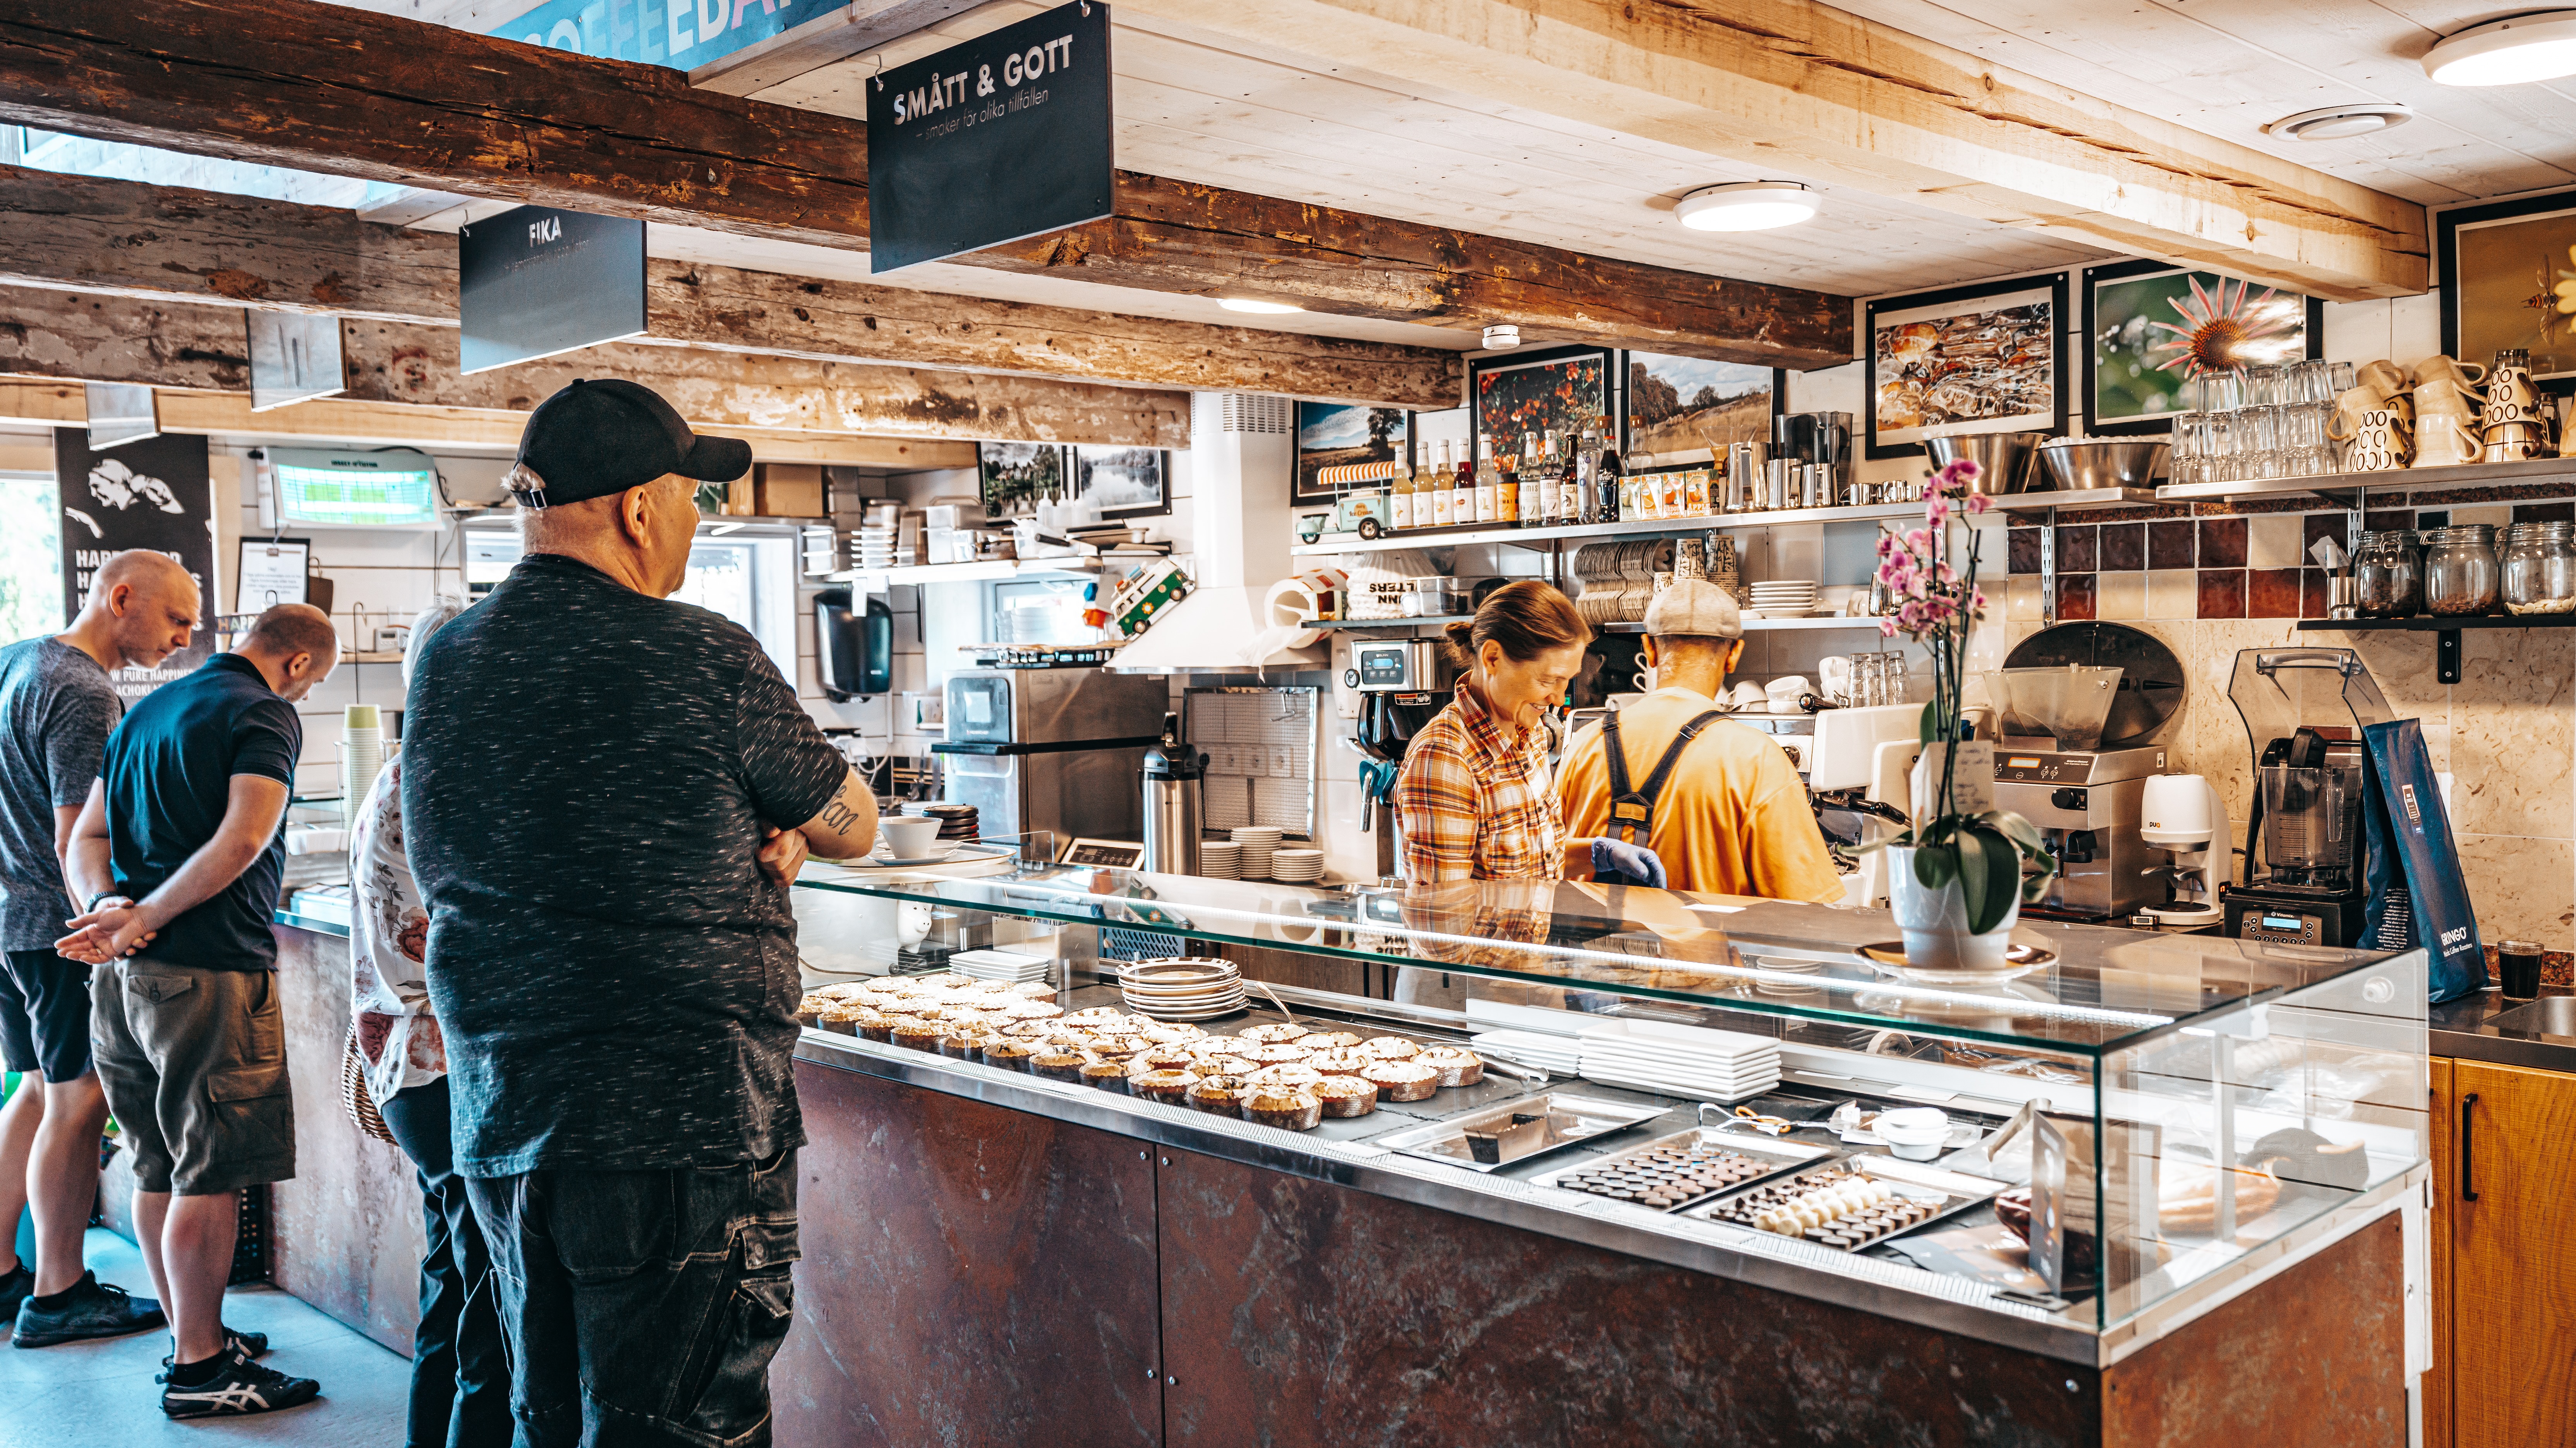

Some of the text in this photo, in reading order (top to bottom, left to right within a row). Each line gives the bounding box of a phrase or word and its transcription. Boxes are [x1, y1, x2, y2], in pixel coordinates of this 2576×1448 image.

[894, 34, 1073, 125] SMÅTT & GOTT
[926, 117, 960, 140] smaker
[963, 108, 977, 127] för
[980, 99, 1005, 122] olika
[1009, 86, 1049, 113] tillfällen
[529, 216, 561, 248] FIKA
[1370, 582, 1417, 593] LTERS
[218, 615, 256, 632] HAPP
[123, 670, 148, 682] PURE
[150, 668, 194, 681] HAPPINE
[2441, 927, 2466, 946] GRINGO
[2449, 946, 2459, 954] Coffee
